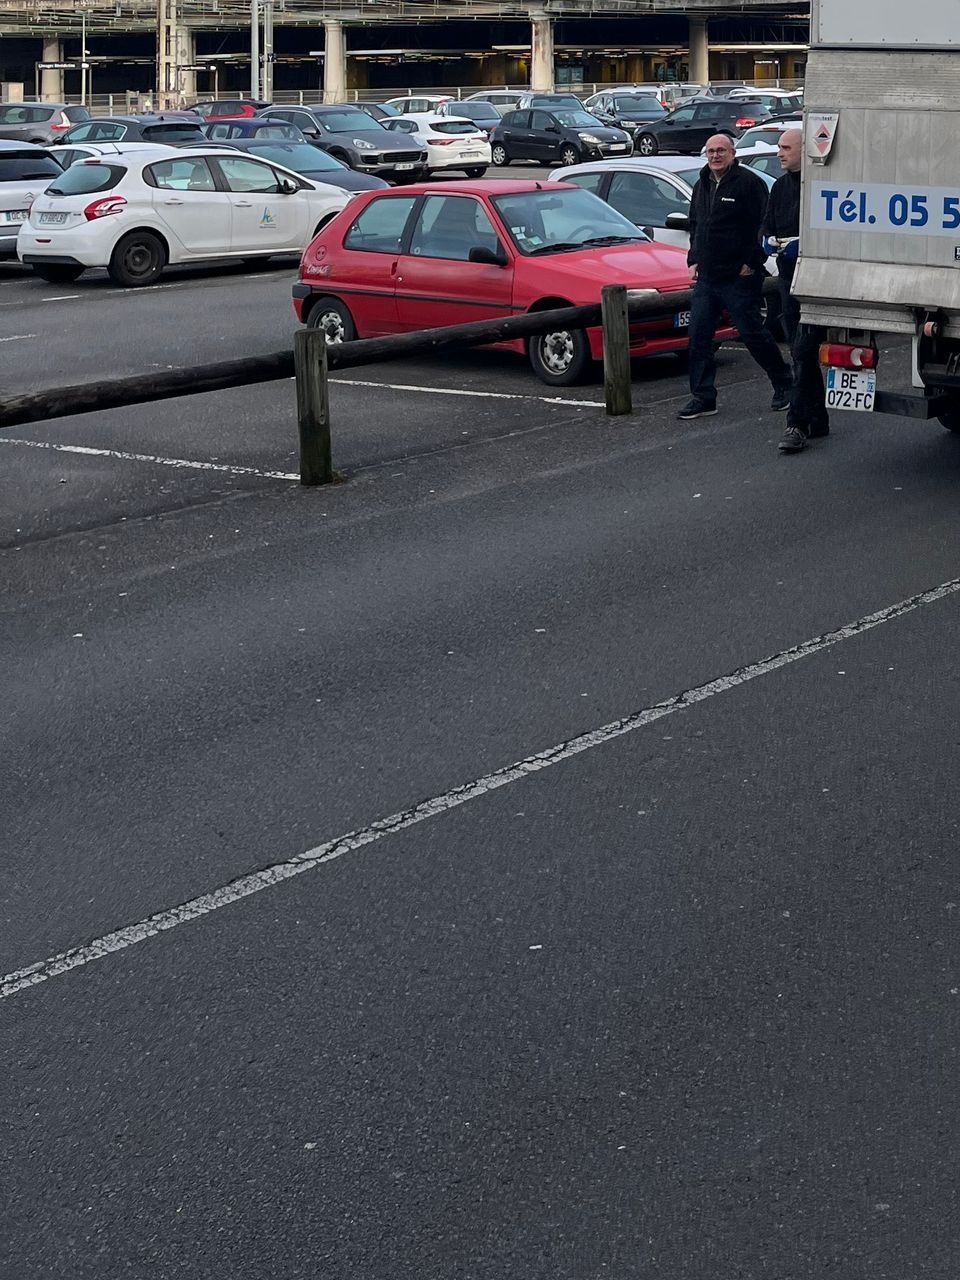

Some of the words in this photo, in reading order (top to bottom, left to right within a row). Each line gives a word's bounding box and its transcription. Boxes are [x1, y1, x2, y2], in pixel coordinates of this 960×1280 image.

[821, 190, 876, 224] Tél.
[889, 194, 928, 226] 05
[828, 390, 872, 409] 072-FC
